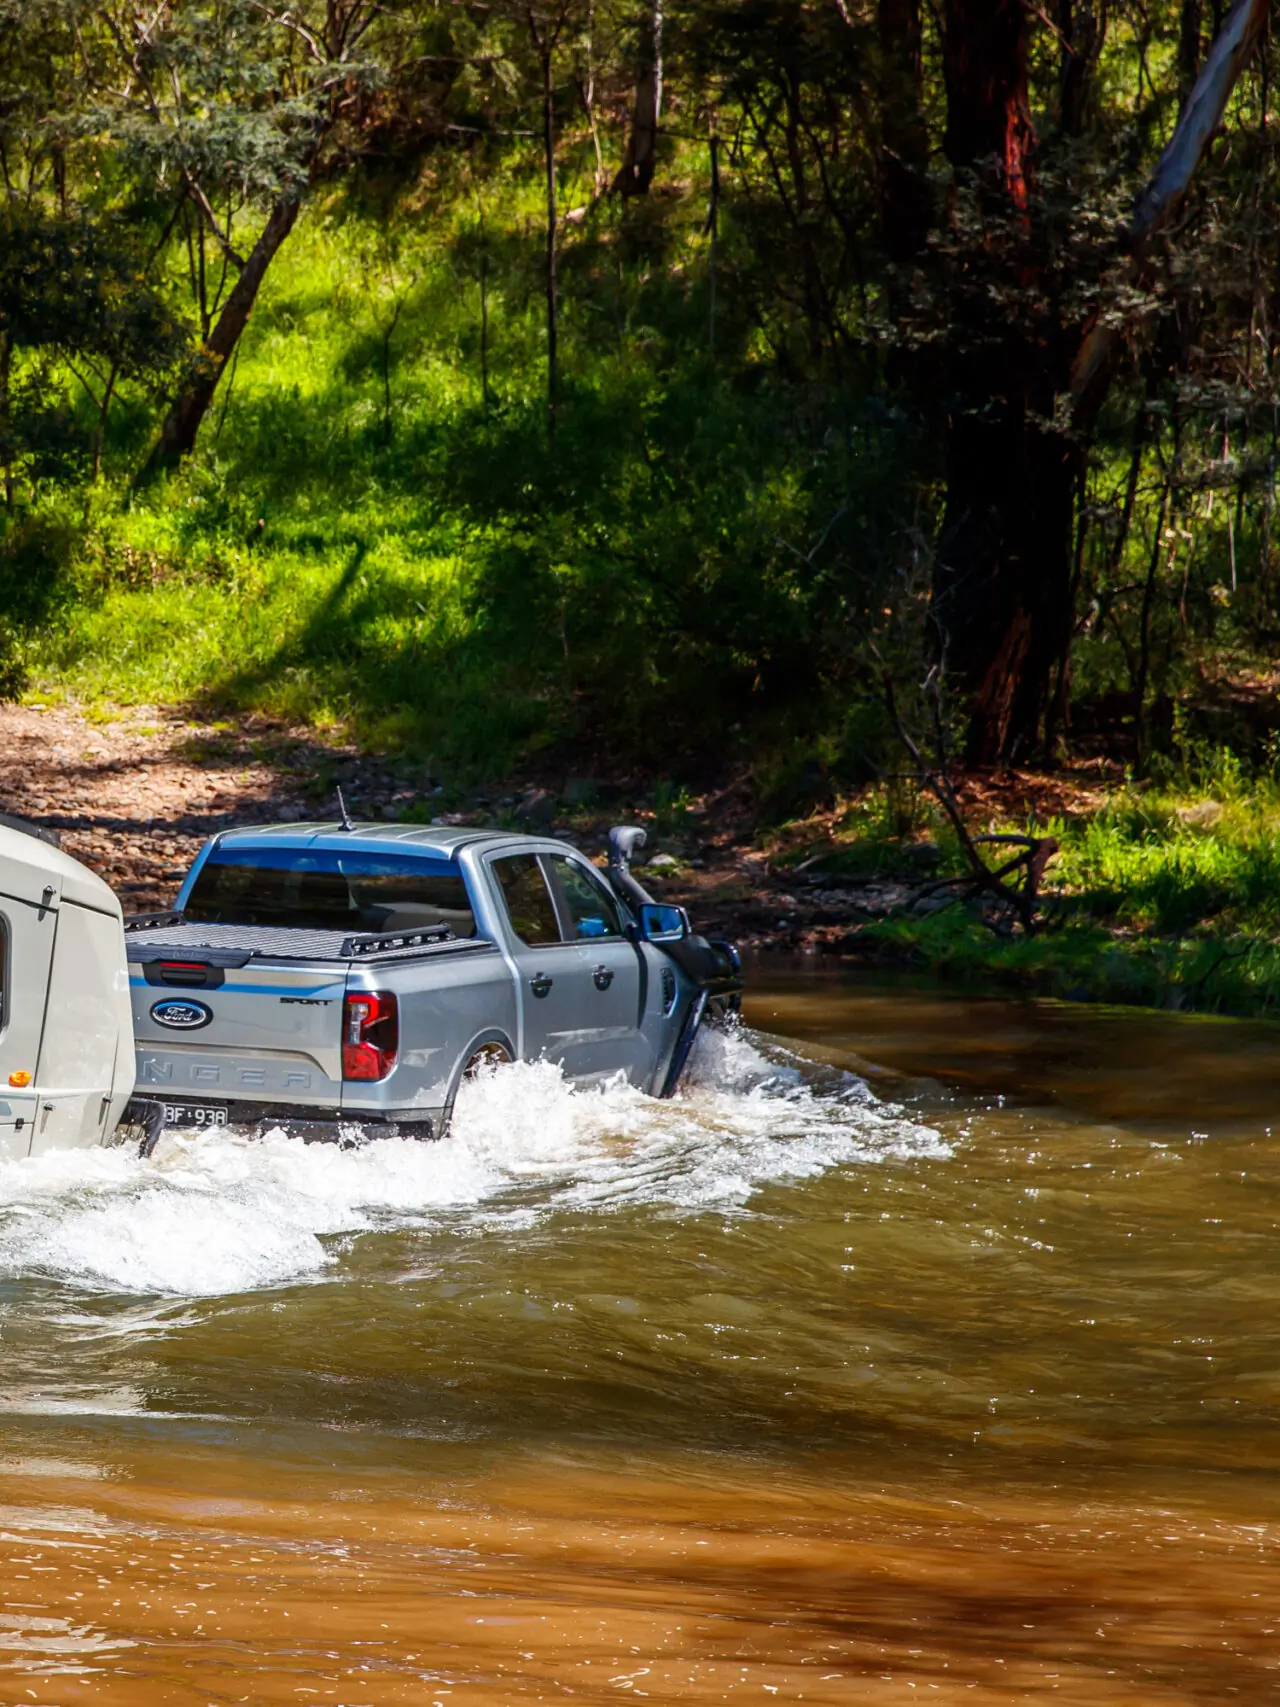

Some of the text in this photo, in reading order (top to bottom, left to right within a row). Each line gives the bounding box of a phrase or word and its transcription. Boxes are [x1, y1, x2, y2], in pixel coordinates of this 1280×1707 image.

[280, 997, 333, 1006] SPORT
[163, 1006, 194, 1021] Ford
[142, 1060, 312, 1089] NGER
